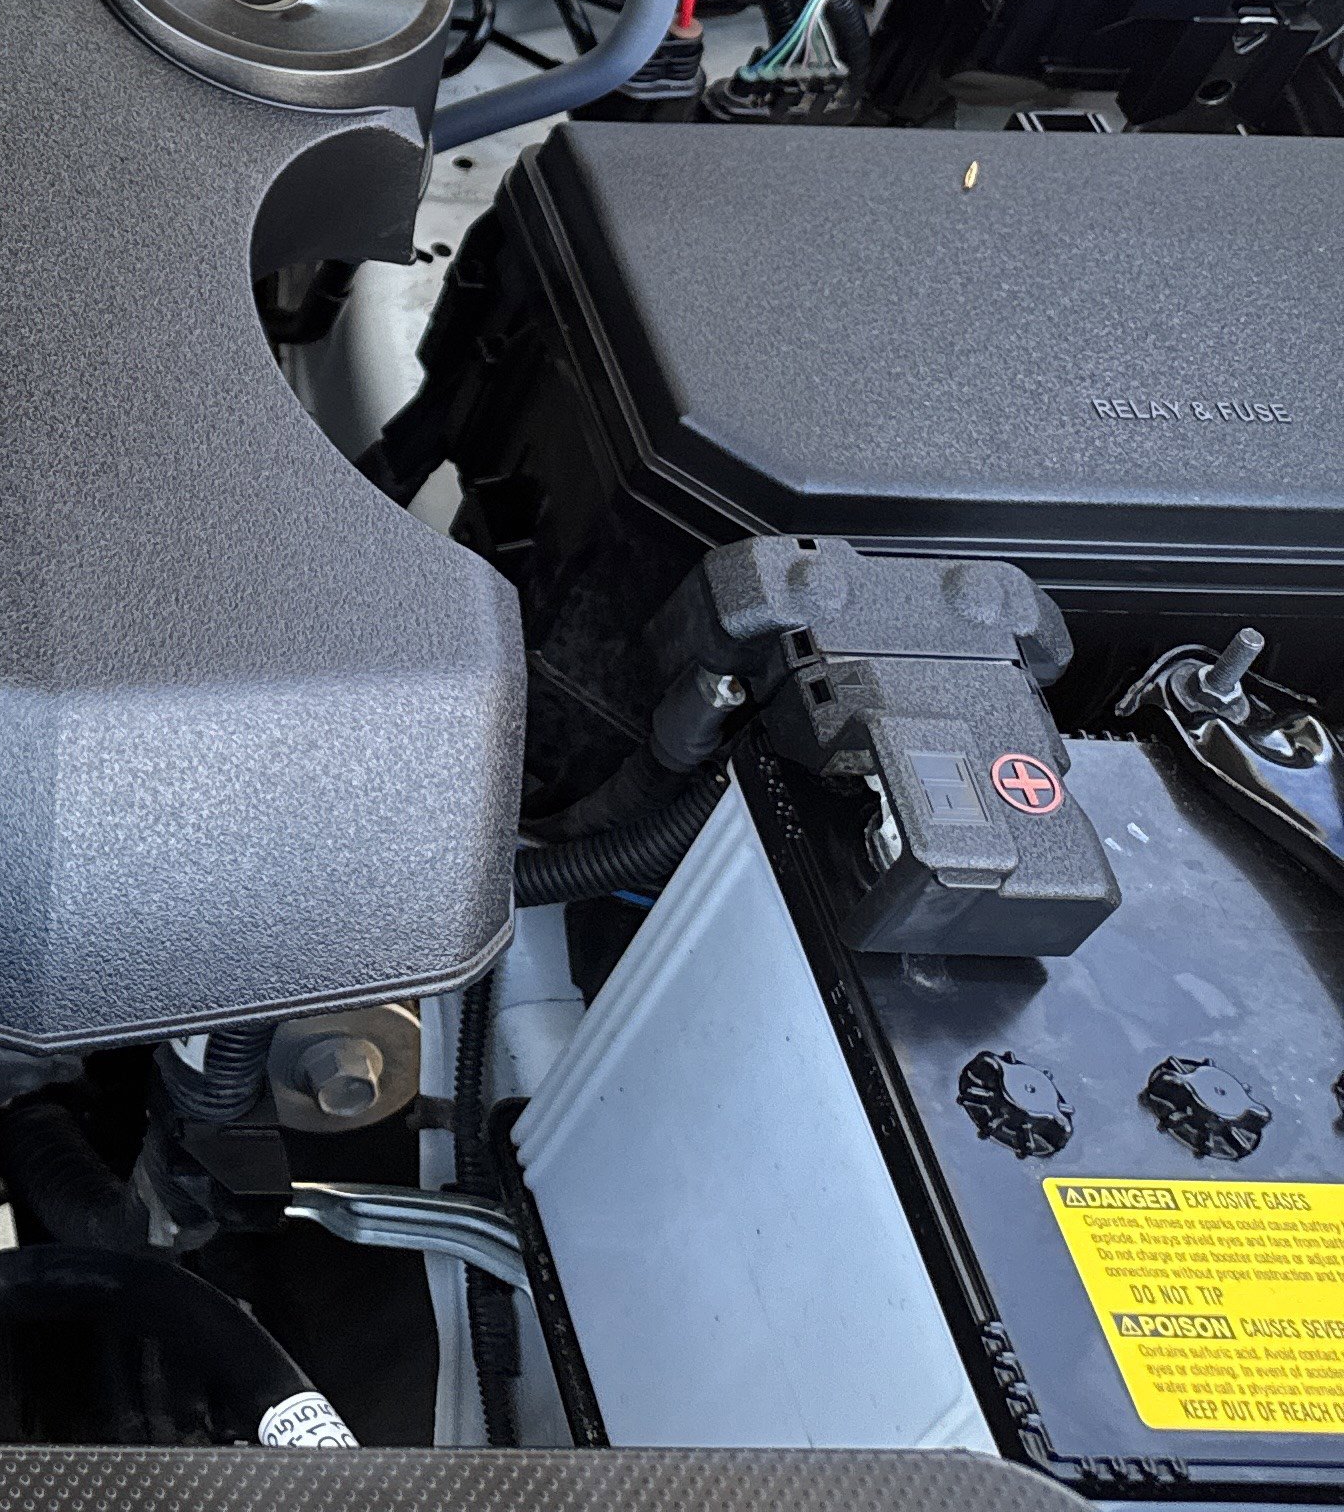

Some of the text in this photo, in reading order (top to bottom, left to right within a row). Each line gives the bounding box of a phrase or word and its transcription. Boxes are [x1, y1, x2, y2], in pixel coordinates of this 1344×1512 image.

[1092, 398, 1292, 424] RELAY & FUSE
[1082, 1187, 1312, 1211] DANGER EXPLOSIVE GASES
[1144, 1216, 1184, 1229] flames
[1184, 1219, 1196, 1229] or
[1198, 1218, 1235, 1231] sparks
[1236, 1218, 1267, 1231] could
[1267, 1220, 1299, 1231] cause
[1299, 1219, 1341, 1235] battery
[1139, 1233, 1181, 1247] Always
[1182, 1234, 1215, 1247] shield
[1216, 1236, 1244, 1249] eyes
[1245, 1235, 1267, 1247] and
[1266, 1235, 1292, 1248] face
[1293, 1235, 1321, 1248] from
[1097, 1248, 1114, 1261] Do
[1115, 1249, 1135, 1261] not
[1136, 1249, 1173, 1264] charge
[1174, 1252, 1187, 1262] or
[1189, 1252, 1210, 1263] use
[1209, 1250, 1252, 1263] booster
[1254, 1250, 1291, 1264] cables
[1292, 1255, 1304, 1265] or
[1105, 1266, 1170, 1279] connections
[1171, 1267, 1214, 1279] without
[1314, 1270, 1337, 1282] and
[1129, 1284, 1224, 1306] DO NOT TIP
[1137, 1316, 1233, 1338] POISON
[1239, 1317, 1302, 1339] CAUSES
[1138, 1343, 1188, 1358] Contains
[1264, 1346, 1297, 1361] Avoid
[1298, 1348, 1341, 1361] contact
[1146, 1364, 1174, 1378] eyes
[1175, 1365, 1188, 1376] or
[1255, 1365, 1289, 1378] event
[1289, 1364, 1302, 1378] of
[1153, 1380, 1189, 1394] water
[1191, 1382, 1214, 1395] and
[1214, 1382, 1236, 1395] call
[1178, 1398, 1218, 1420] KEEP
[1221, 1399, 1255, 1422] OUT
[1255, 1400, 1277, 1422] OF
[1278, 1400, 1335, 1423] REACH
